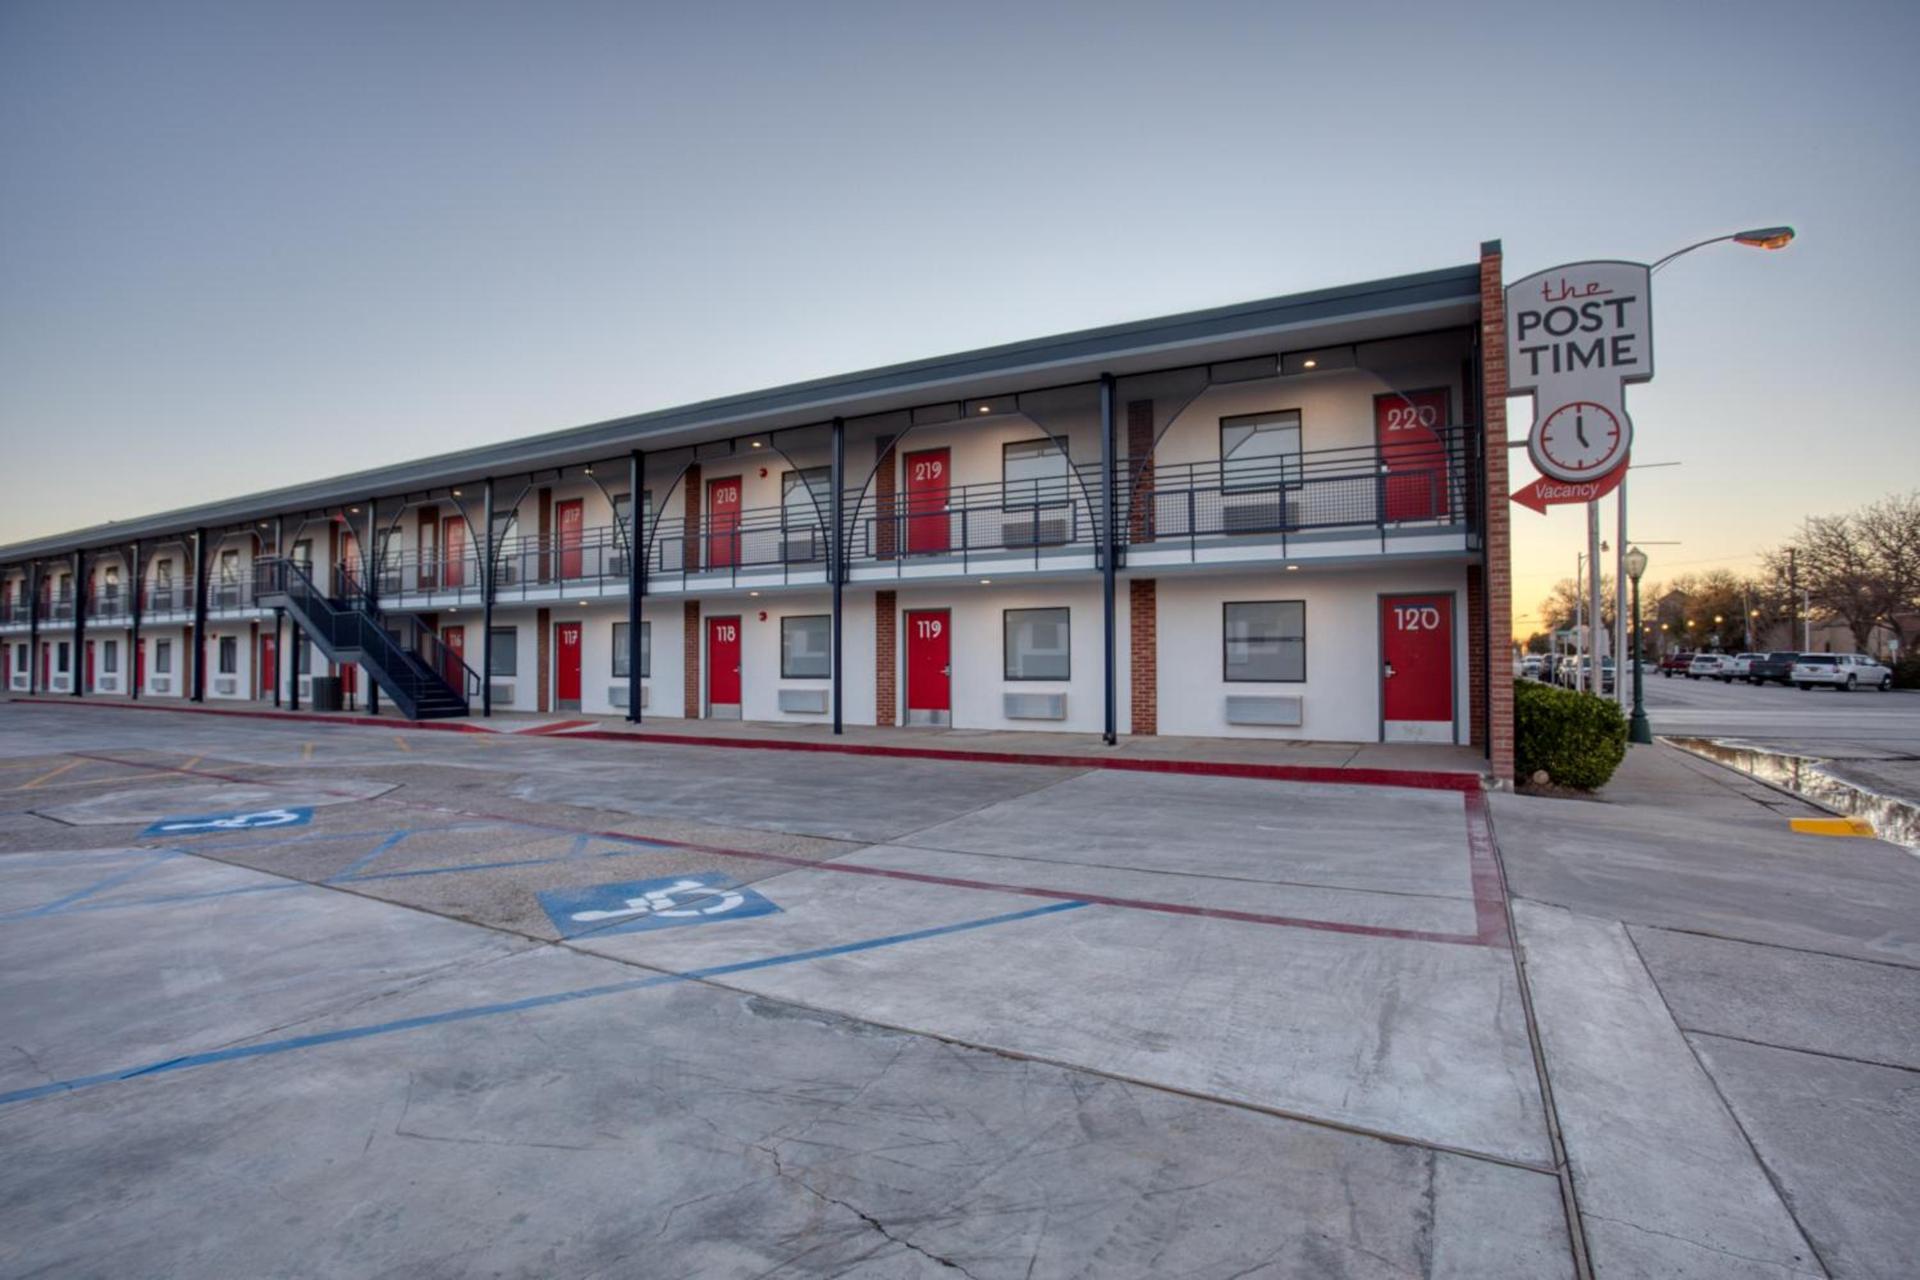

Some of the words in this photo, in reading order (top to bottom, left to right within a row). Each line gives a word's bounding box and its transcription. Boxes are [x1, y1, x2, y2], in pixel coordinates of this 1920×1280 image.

[1541, 278, 1614, 302] the
[1517, 295, 1636, 341] POST
[1519, 334, 1638, 376] TIME
[1387, 405, 1436, 430] 220
[915, 461, 942, 480] 219
[716, 487, 737, 504] 218
[1535, 483, 1600, 500] Vacancy
[1394, 607, 1440, 630] 120
[562, 630, 578, 646] 117
[716, 625, 736, 642] 118
[917, 620, 942, 639] 119
